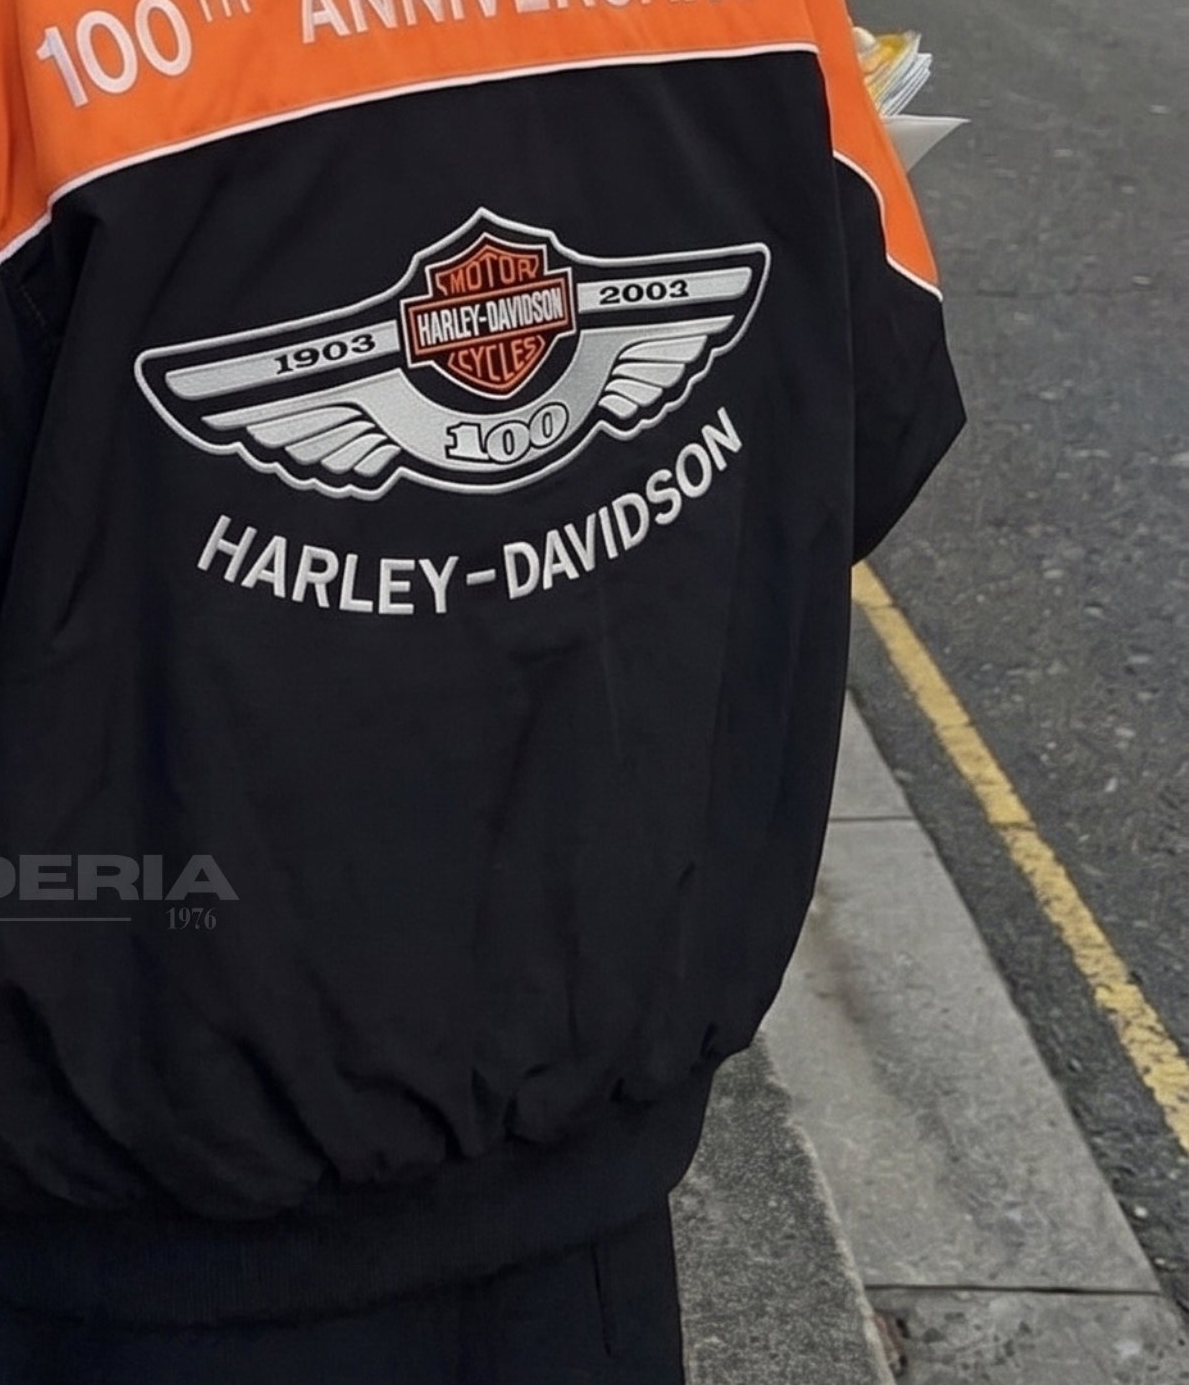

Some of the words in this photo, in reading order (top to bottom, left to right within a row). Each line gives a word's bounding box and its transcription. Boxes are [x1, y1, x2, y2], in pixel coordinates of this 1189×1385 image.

[449, 251, 537, 295] MOTOR
[598, 279, 690, 306] 2003
[416, 286, 565, 348] HARLEY-DAVIDSON
[273, 333, 377, 376] 1903
[457, 335, 538, 382] CYCLES
[446, 402, 569, 464] 100
